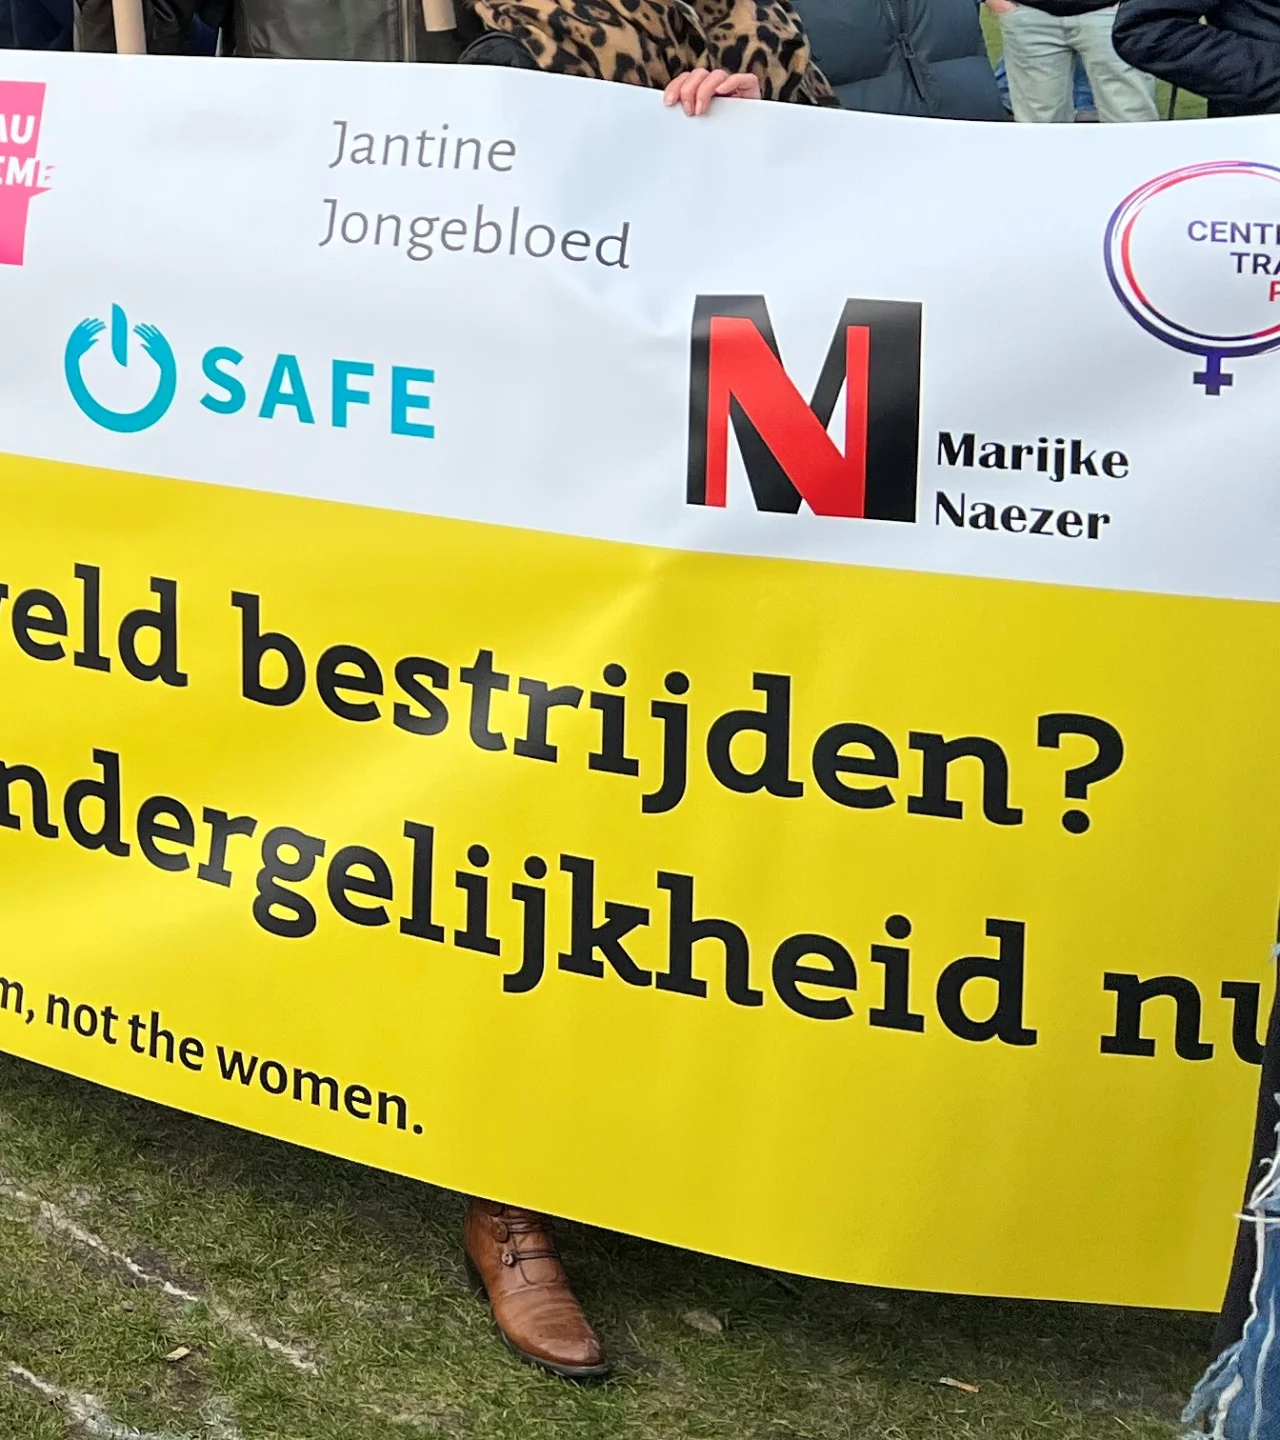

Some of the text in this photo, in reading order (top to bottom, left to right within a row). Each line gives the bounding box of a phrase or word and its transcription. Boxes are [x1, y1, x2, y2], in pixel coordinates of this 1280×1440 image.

[328, 120, 517, 172] Jantine
[318, 198, 631, 269] Jongebloed
[199, 345, 436, 439] SAFE
[937, 431, 1129, 481] Marijke
[935, 491, 1111, 540] Naezer
[230, 590, 1123, 834] bestrijden?
[46, 991, 119, 1045] not
[128, 1012, 204, 1071] the
[216, 1044, 424, 1135] women.
